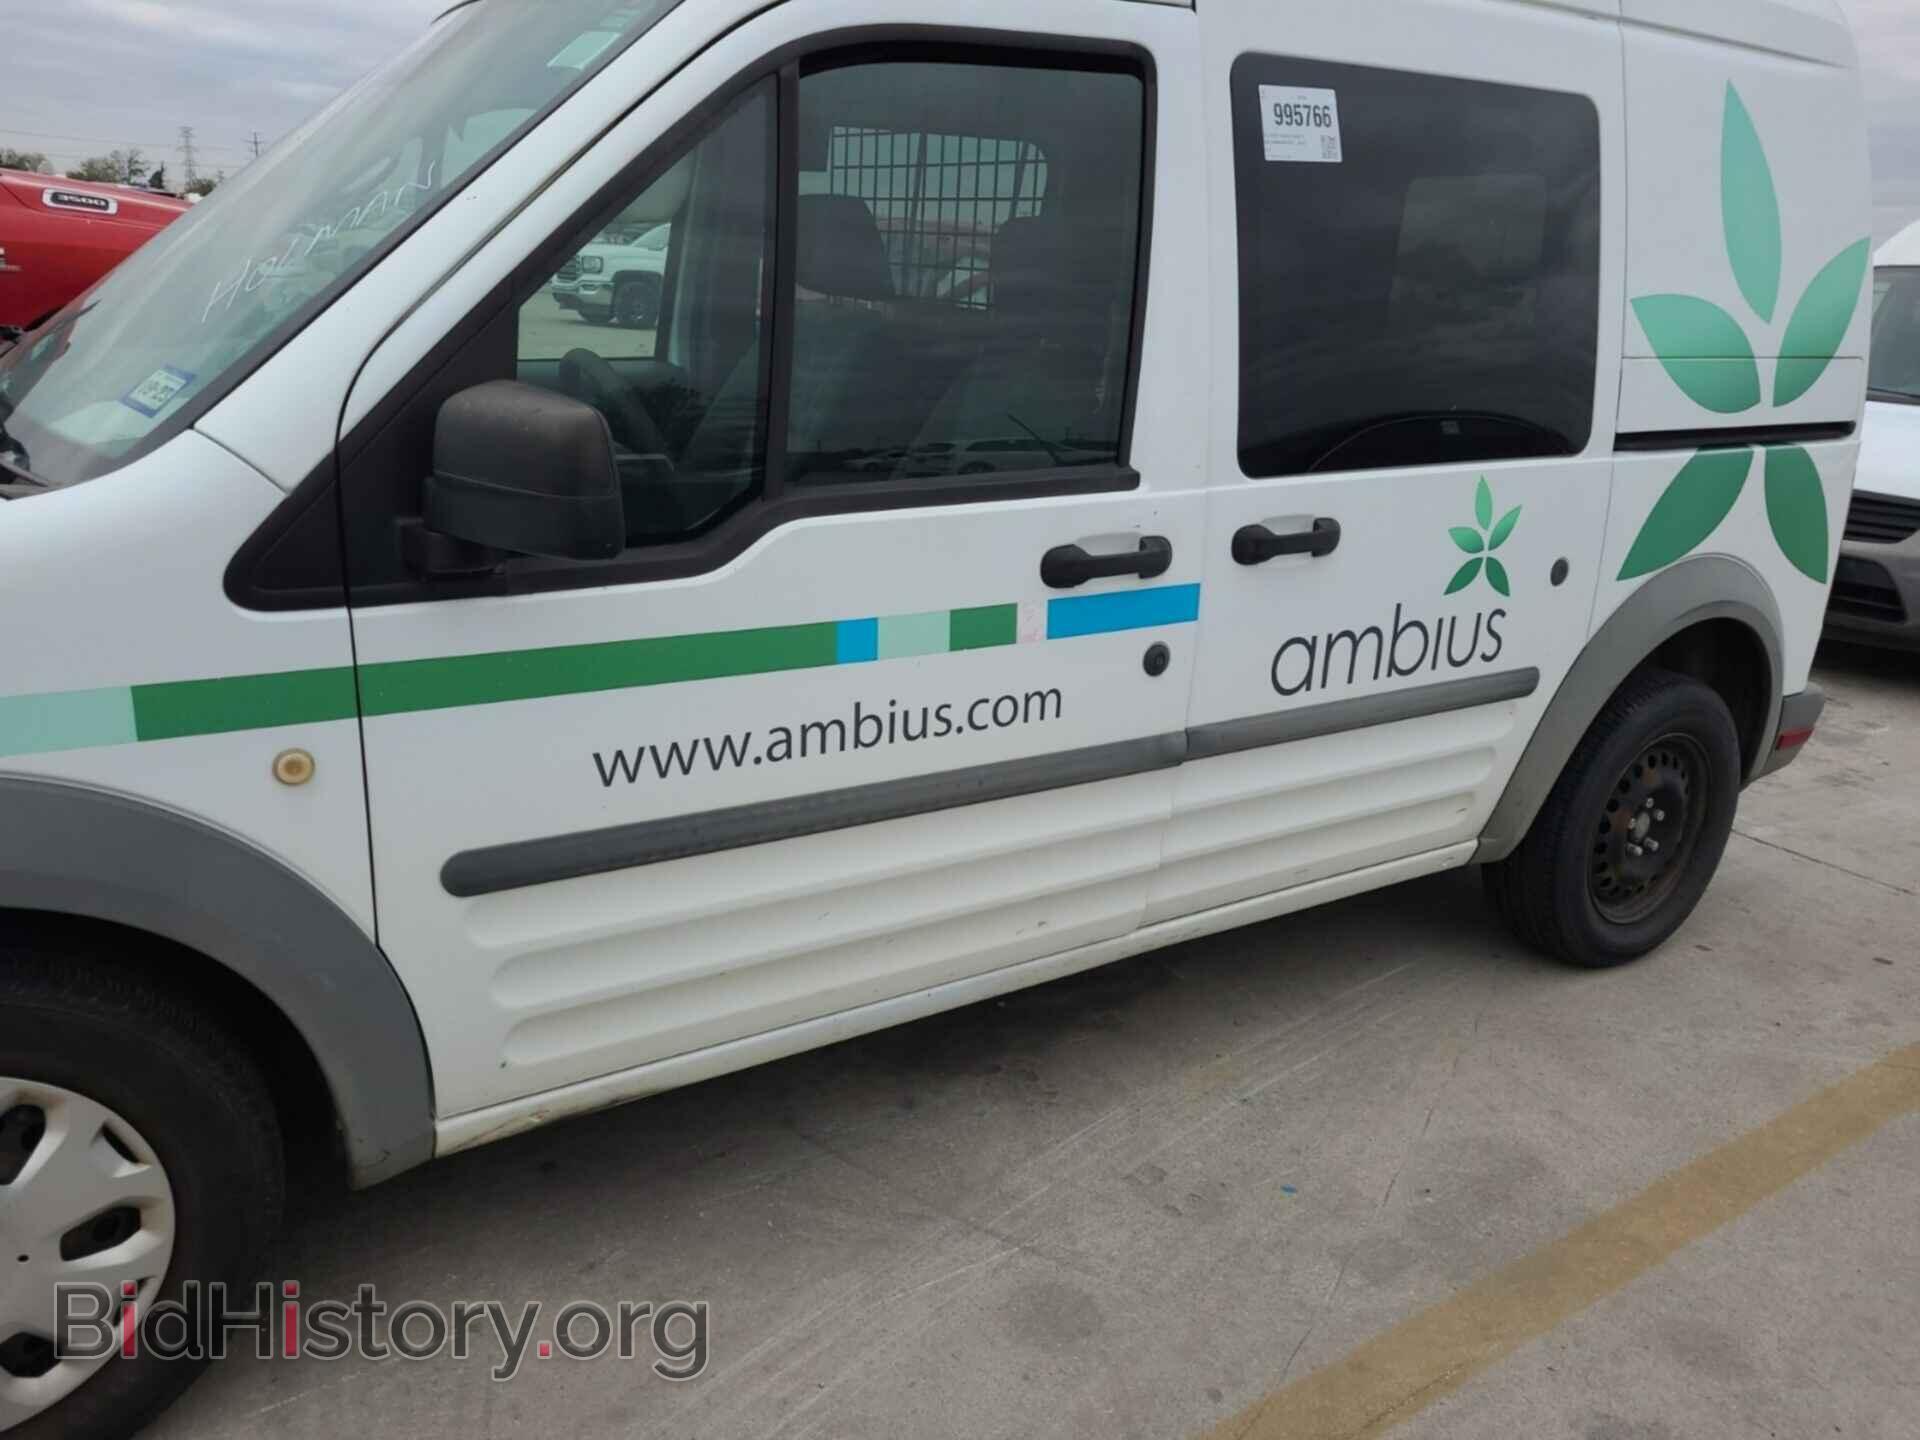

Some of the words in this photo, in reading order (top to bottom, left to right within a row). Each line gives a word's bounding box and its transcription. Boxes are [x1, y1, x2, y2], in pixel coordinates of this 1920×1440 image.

[1273, 102, 1332, 128] 995766
[1270, 602, 1507, 697] ambius
[592, 686, 1063, 788] www.ambius.com
